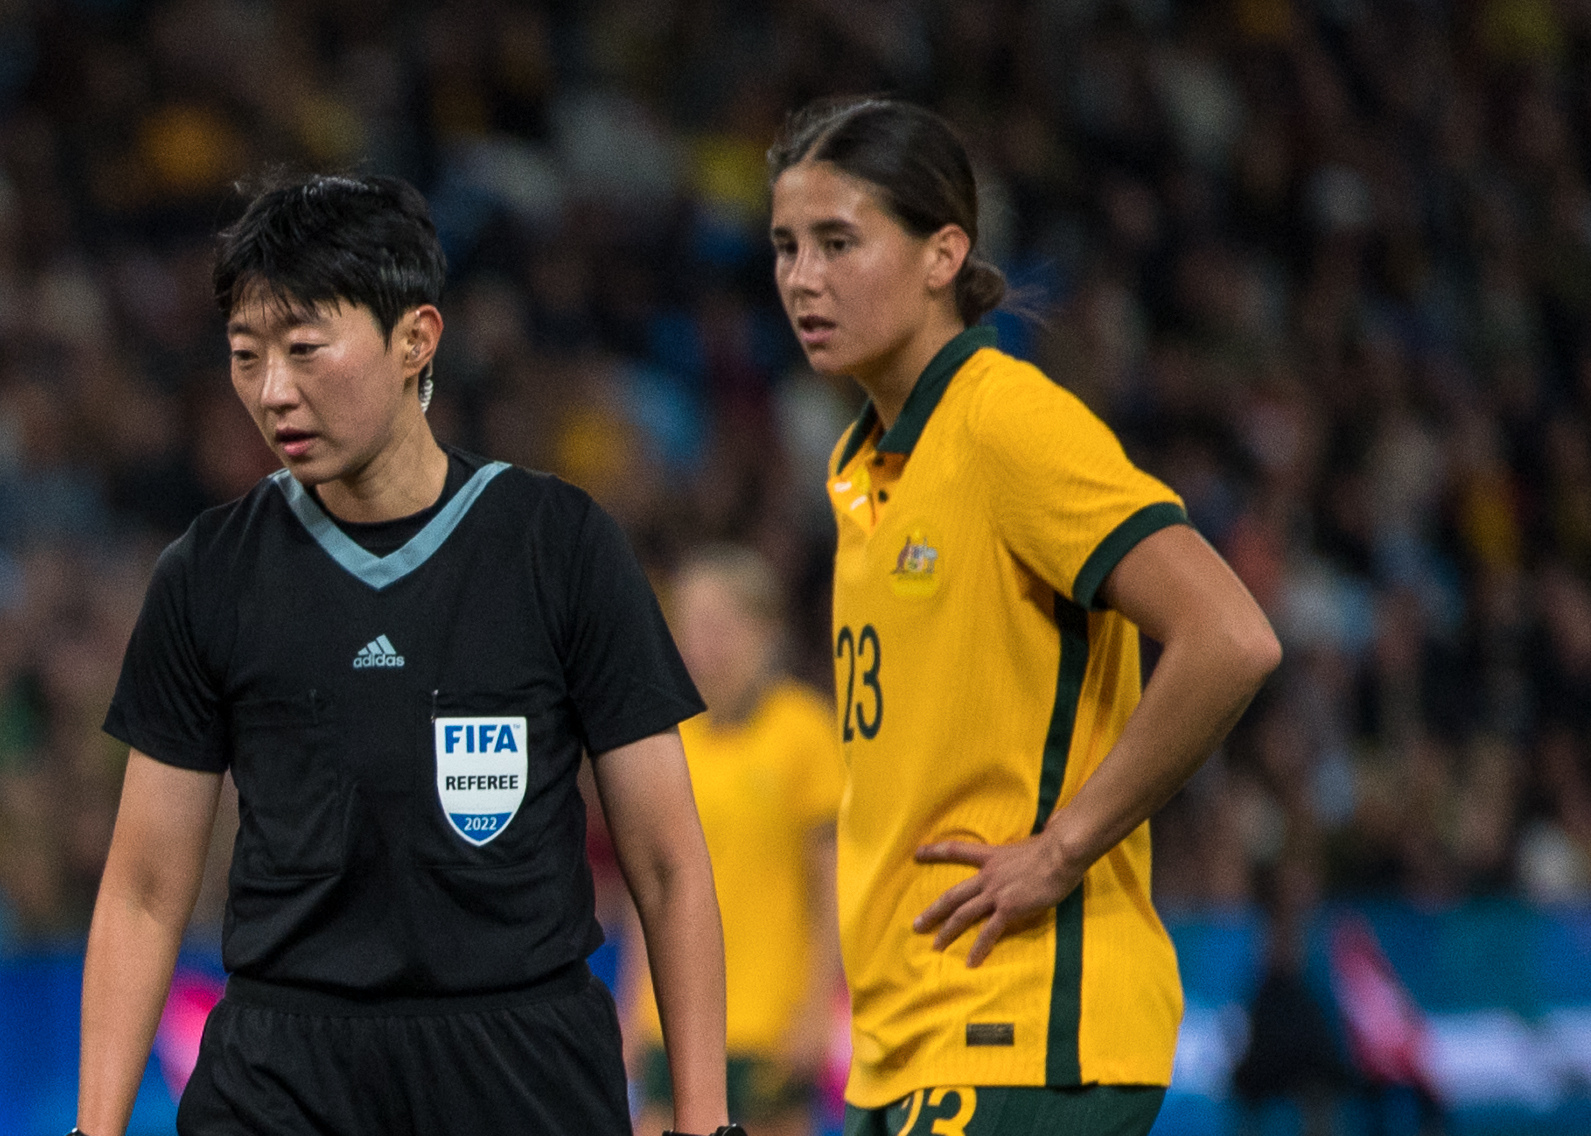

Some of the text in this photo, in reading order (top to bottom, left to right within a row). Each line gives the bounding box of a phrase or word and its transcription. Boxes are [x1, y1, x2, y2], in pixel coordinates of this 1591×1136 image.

[353, 653, 405, 669] adidas
[837, 624, 884, 743] 23
[445, 724, 518, 753] FIFA
[446, 774, 519, 790] REFEREE
[464, 816, 497, 831] 2022
